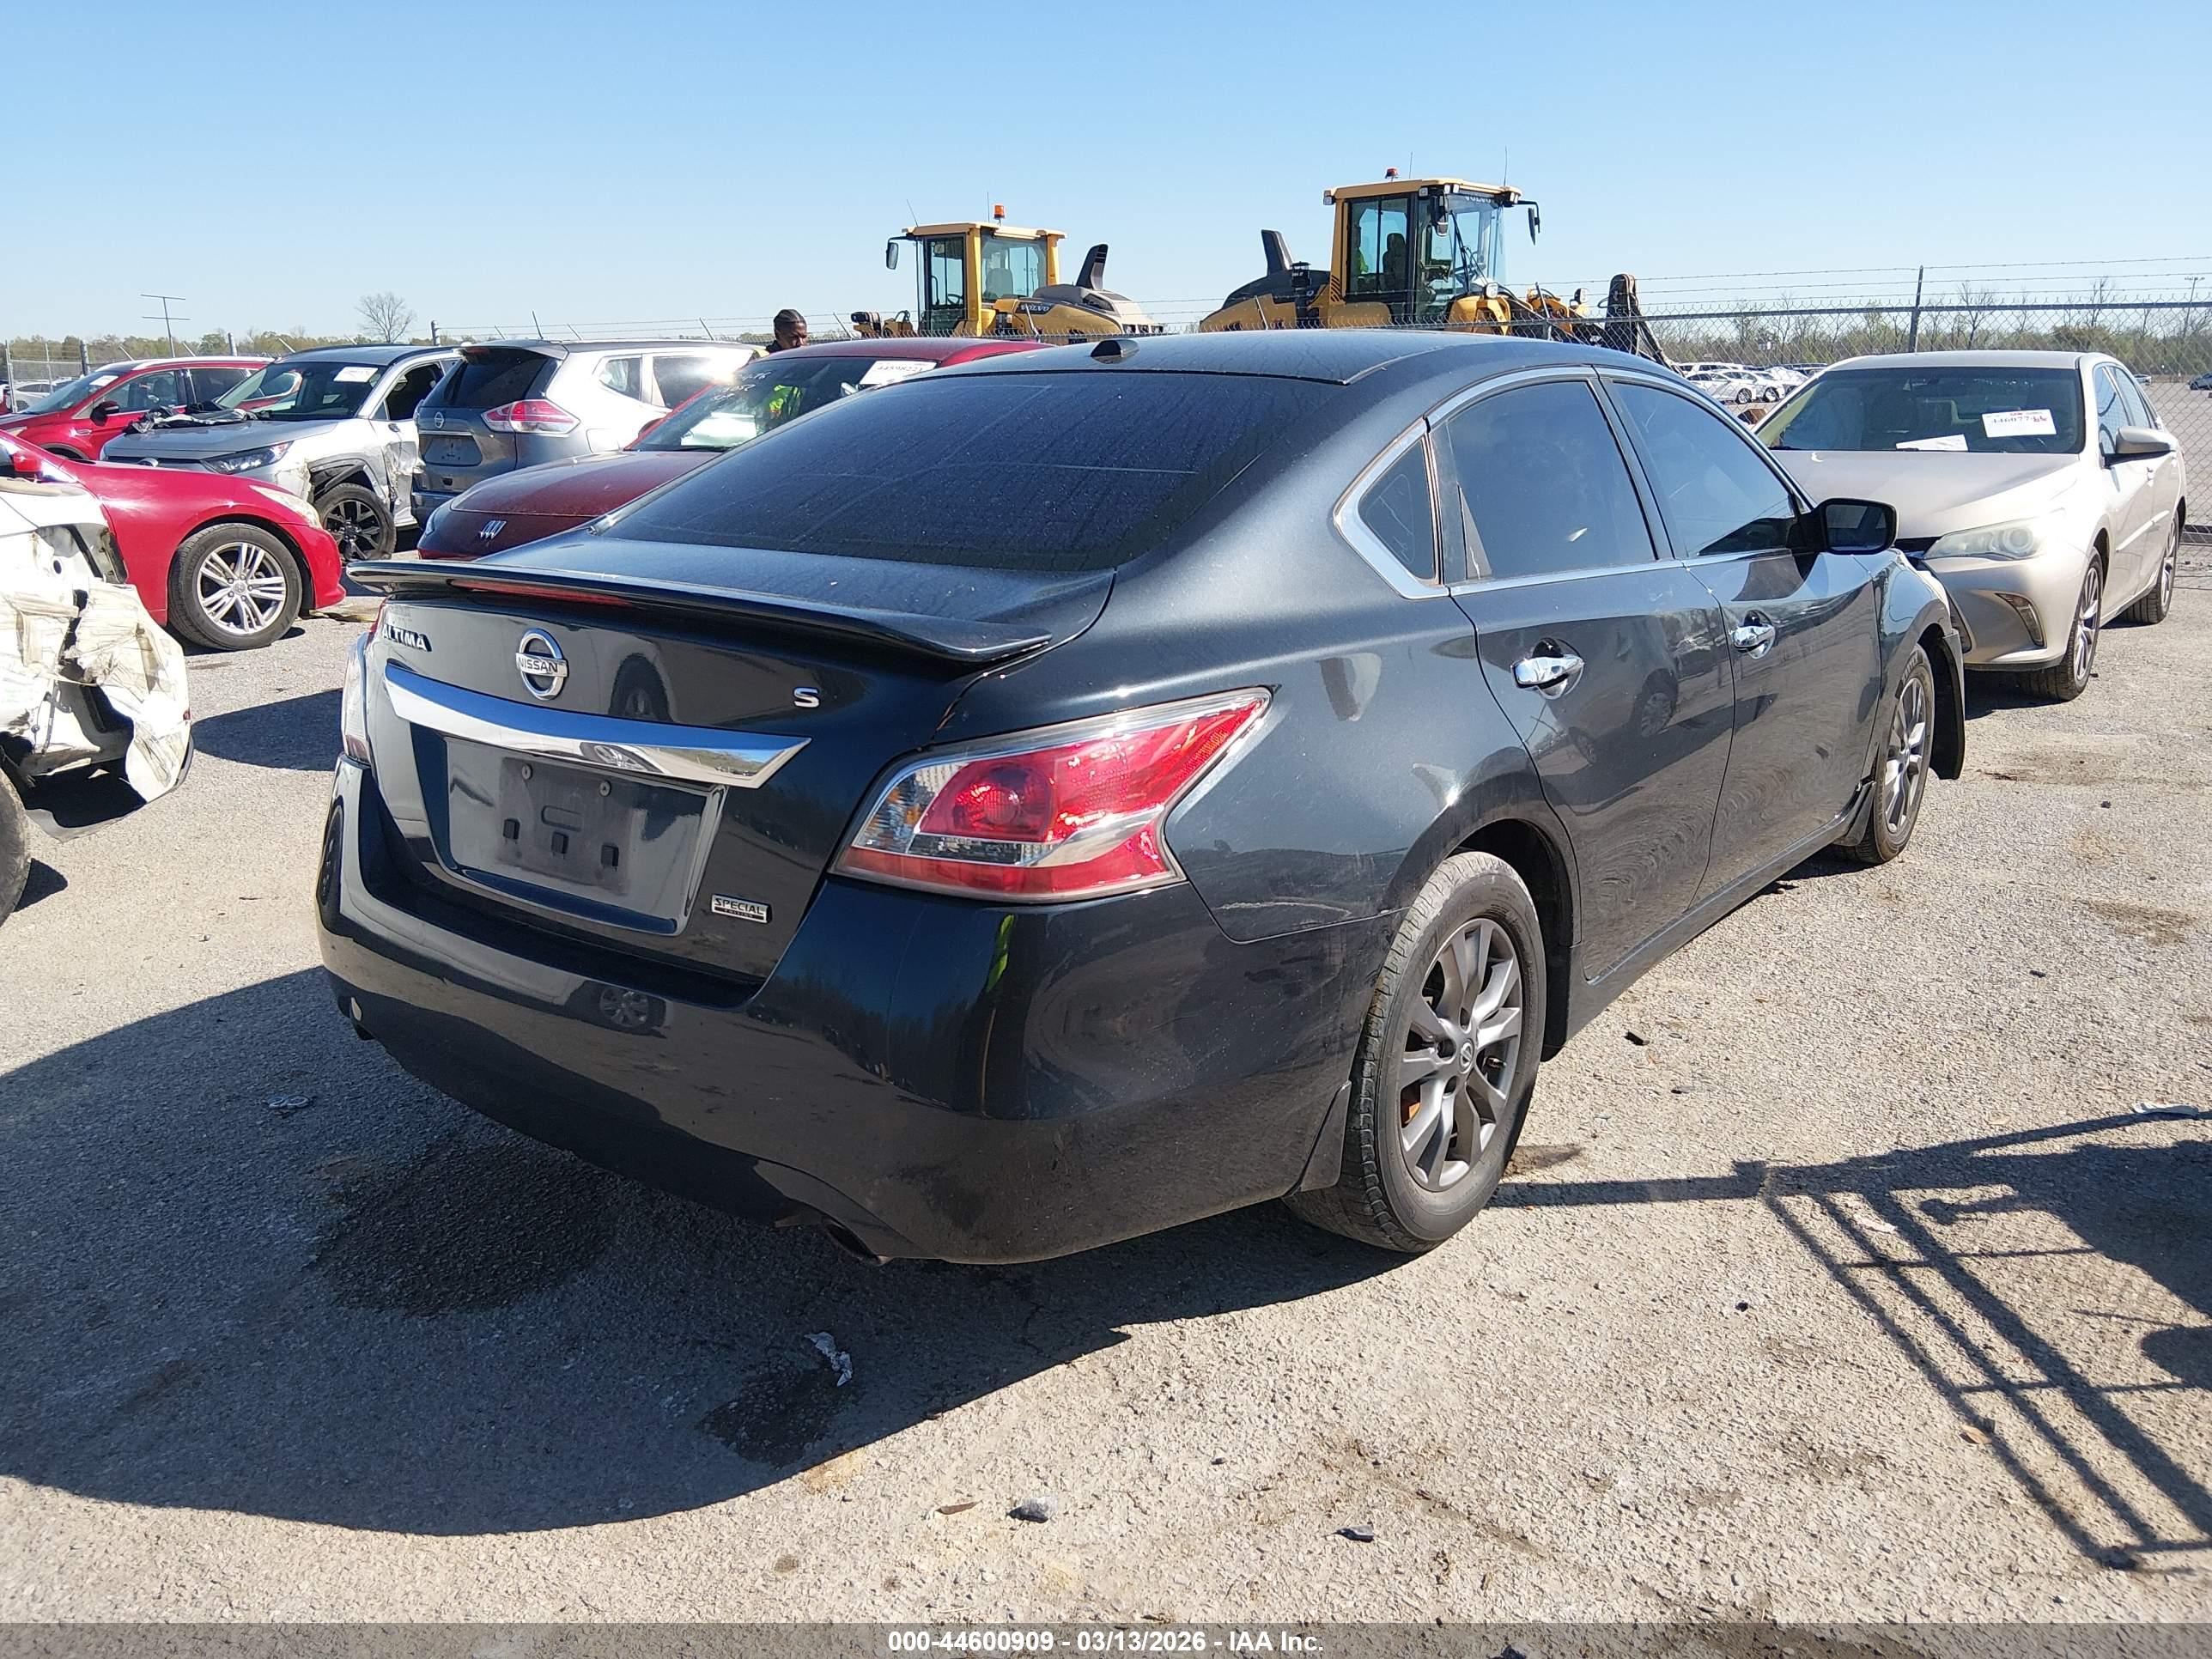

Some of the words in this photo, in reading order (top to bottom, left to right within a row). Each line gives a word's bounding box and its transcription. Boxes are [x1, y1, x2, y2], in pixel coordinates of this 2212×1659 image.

[1020, 303, 1050, 312] VOLVO
[382, 623, 429, 652] ALTIMA
[518, 656, 558, 673] NISSAN
[793, 687, 819, 708] S
[714, 897, 764, 915] SPECIAL
